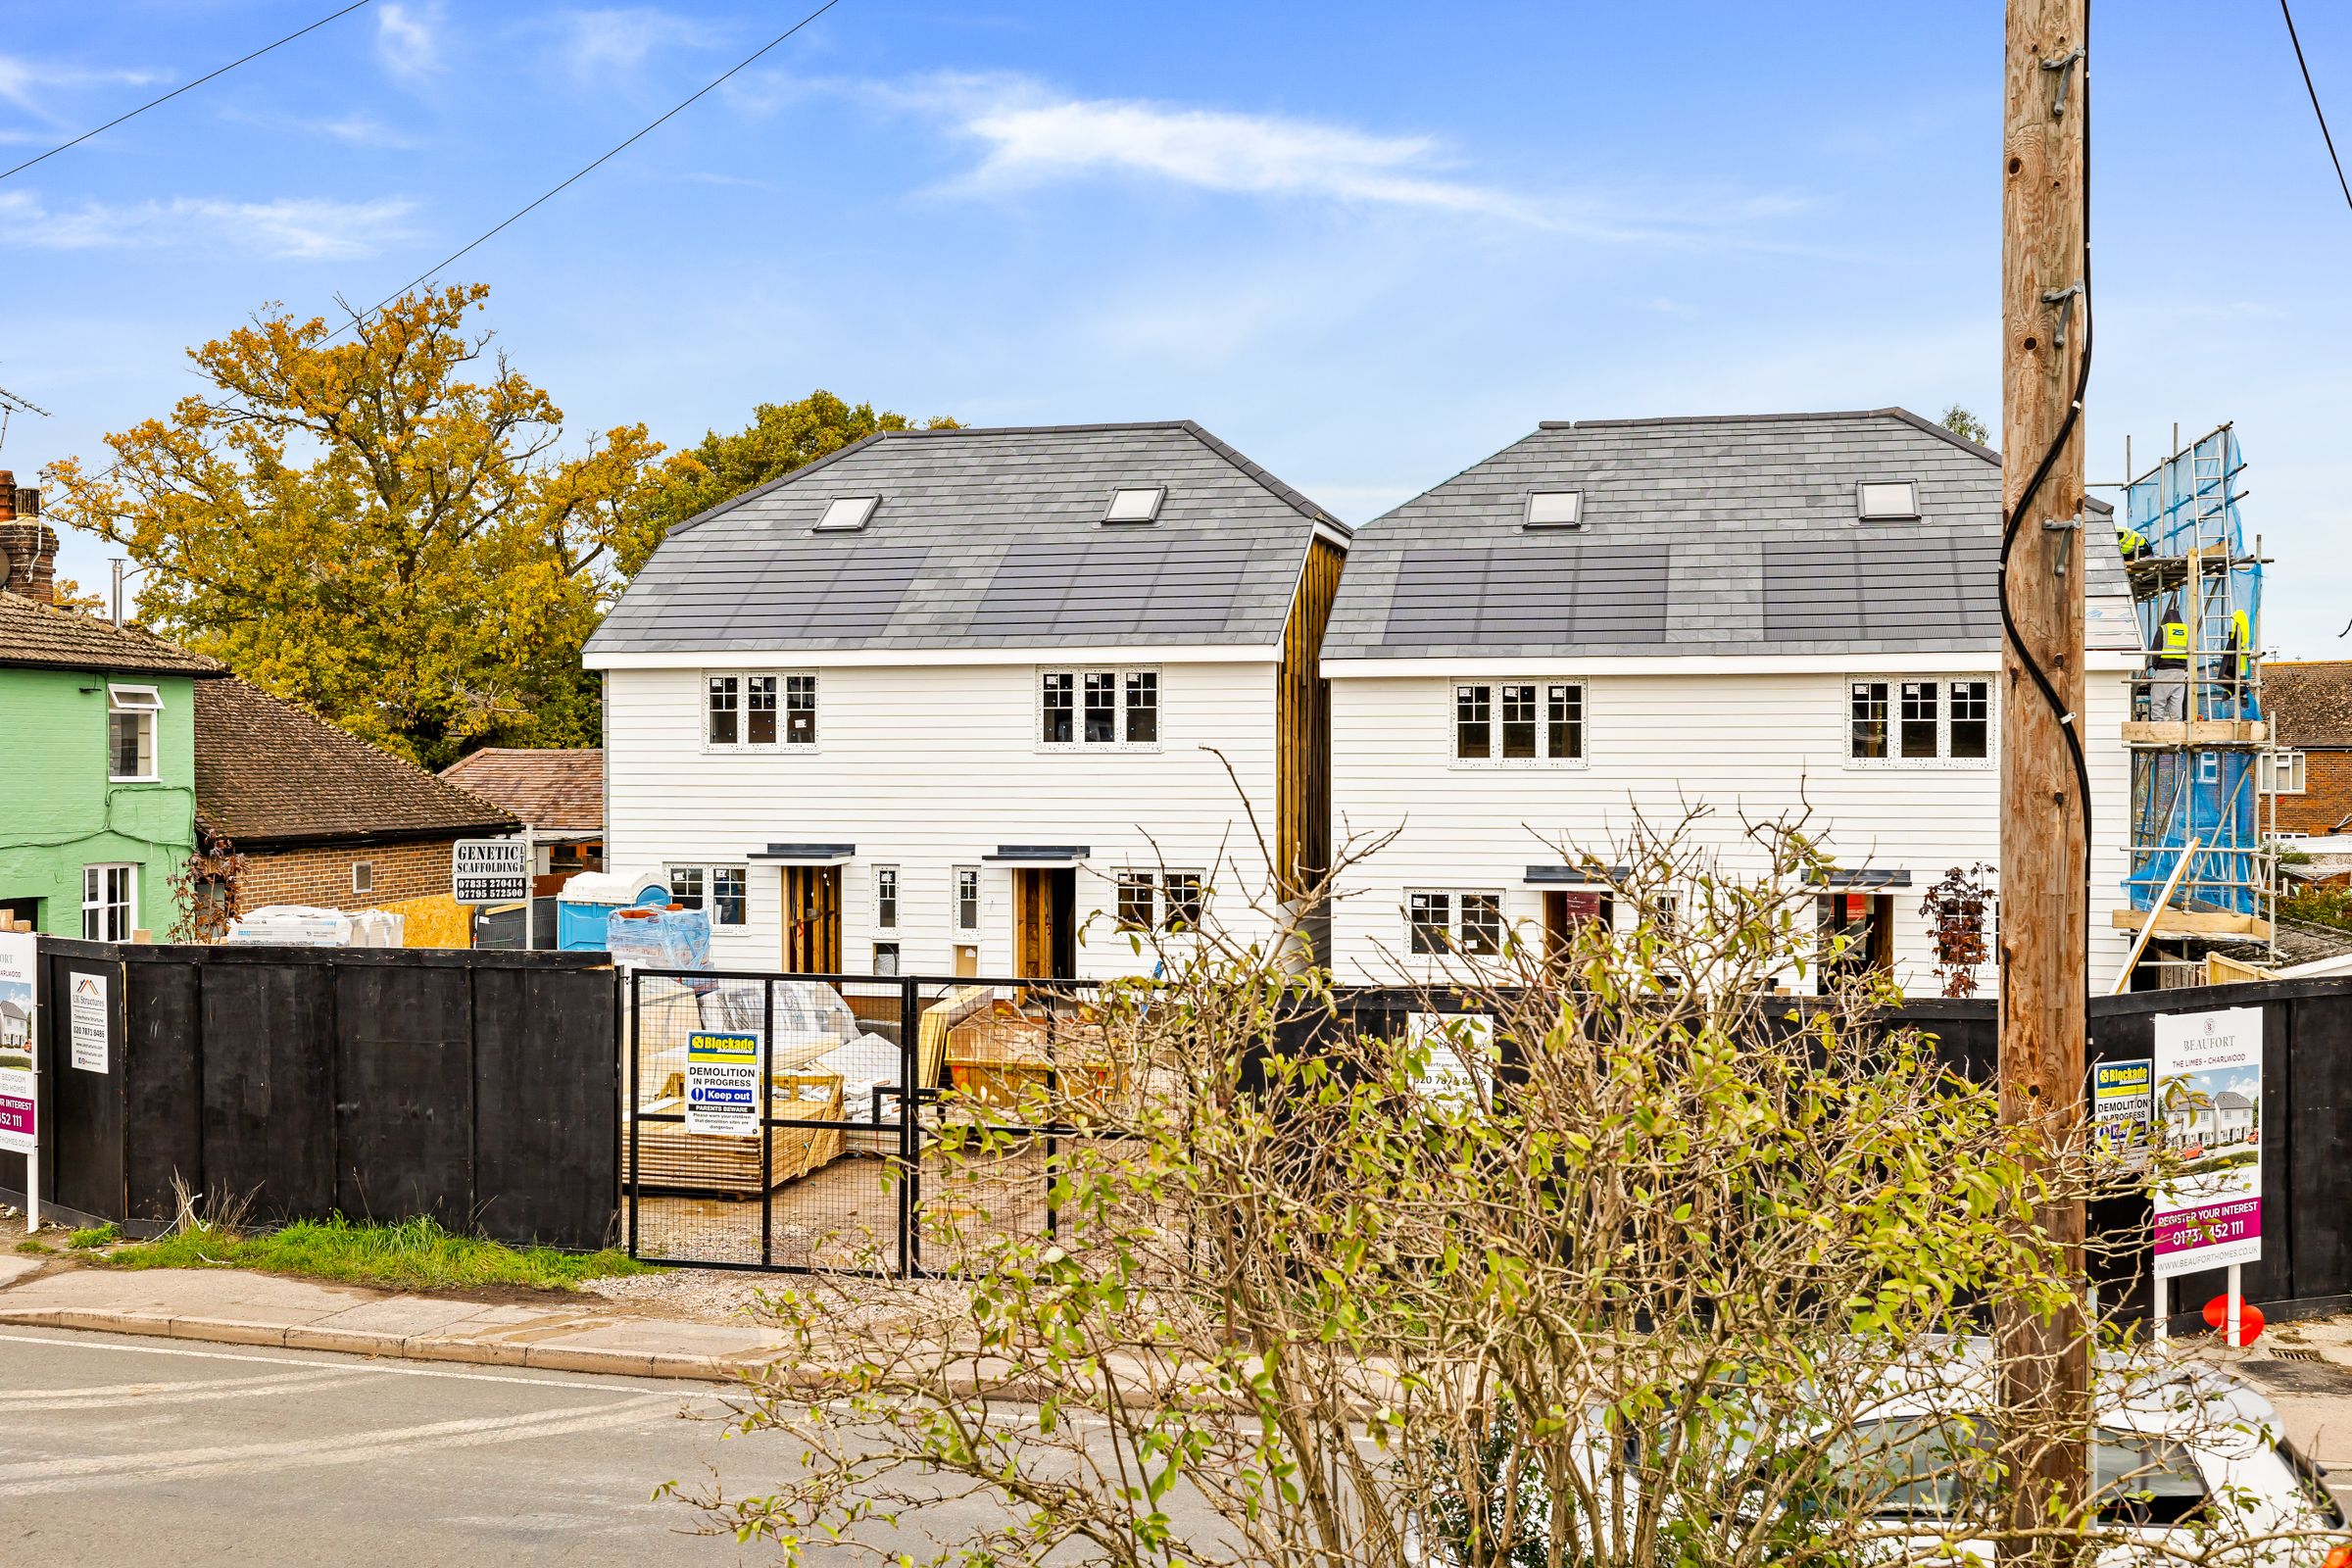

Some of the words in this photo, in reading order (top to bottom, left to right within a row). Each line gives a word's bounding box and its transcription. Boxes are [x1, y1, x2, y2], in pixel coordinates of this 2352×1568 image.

[458, 846, 518, 860] GENETIC
[457, 862, 518, 873] SCAFFOLDING
[458, 879, 488, 888] 07835
[489, 878, 523, 888] 270414
[458, 889, 488, 899] 07795
[489, 888, 523, 898] 572500
[73, 995, 80, 1004] UK
[80, 996, 105, 1007] Structures
[705, 1036, 755, 1050] Blockade
[2183, 1036, 2235, 1052] BEAUFORT
[2208, 1054, 2246, 1064] CHARLWOOD
[689, 1066, 756, 1077] DEMOLITION
[2109, 1067, 2148, 1082] Blockade
[704, 1078, 752, 1087] PROGRESS
[708, 1090, 732, 1101] Keep
[734, 1092, 751, 1101] out
[6, 1100, 32, 1111] INTEREST
[2097, 1099, 2148, 1113] DEMOLITON
[13, 1114, 23, 1128] 111
[2158, 1211, 2197, 1226] REGISTER
[2198, 1207, 2220, 1220] YOUR
[2222, 1201, 2258, 1216] INTEREST
[2208, 1223, 2229, 1239] 452
[2230, 1220, 2244, 1235] 111
[2158, 1246, 2259, 1271] WWW.BEAUFORTHOMES.CO.UK
